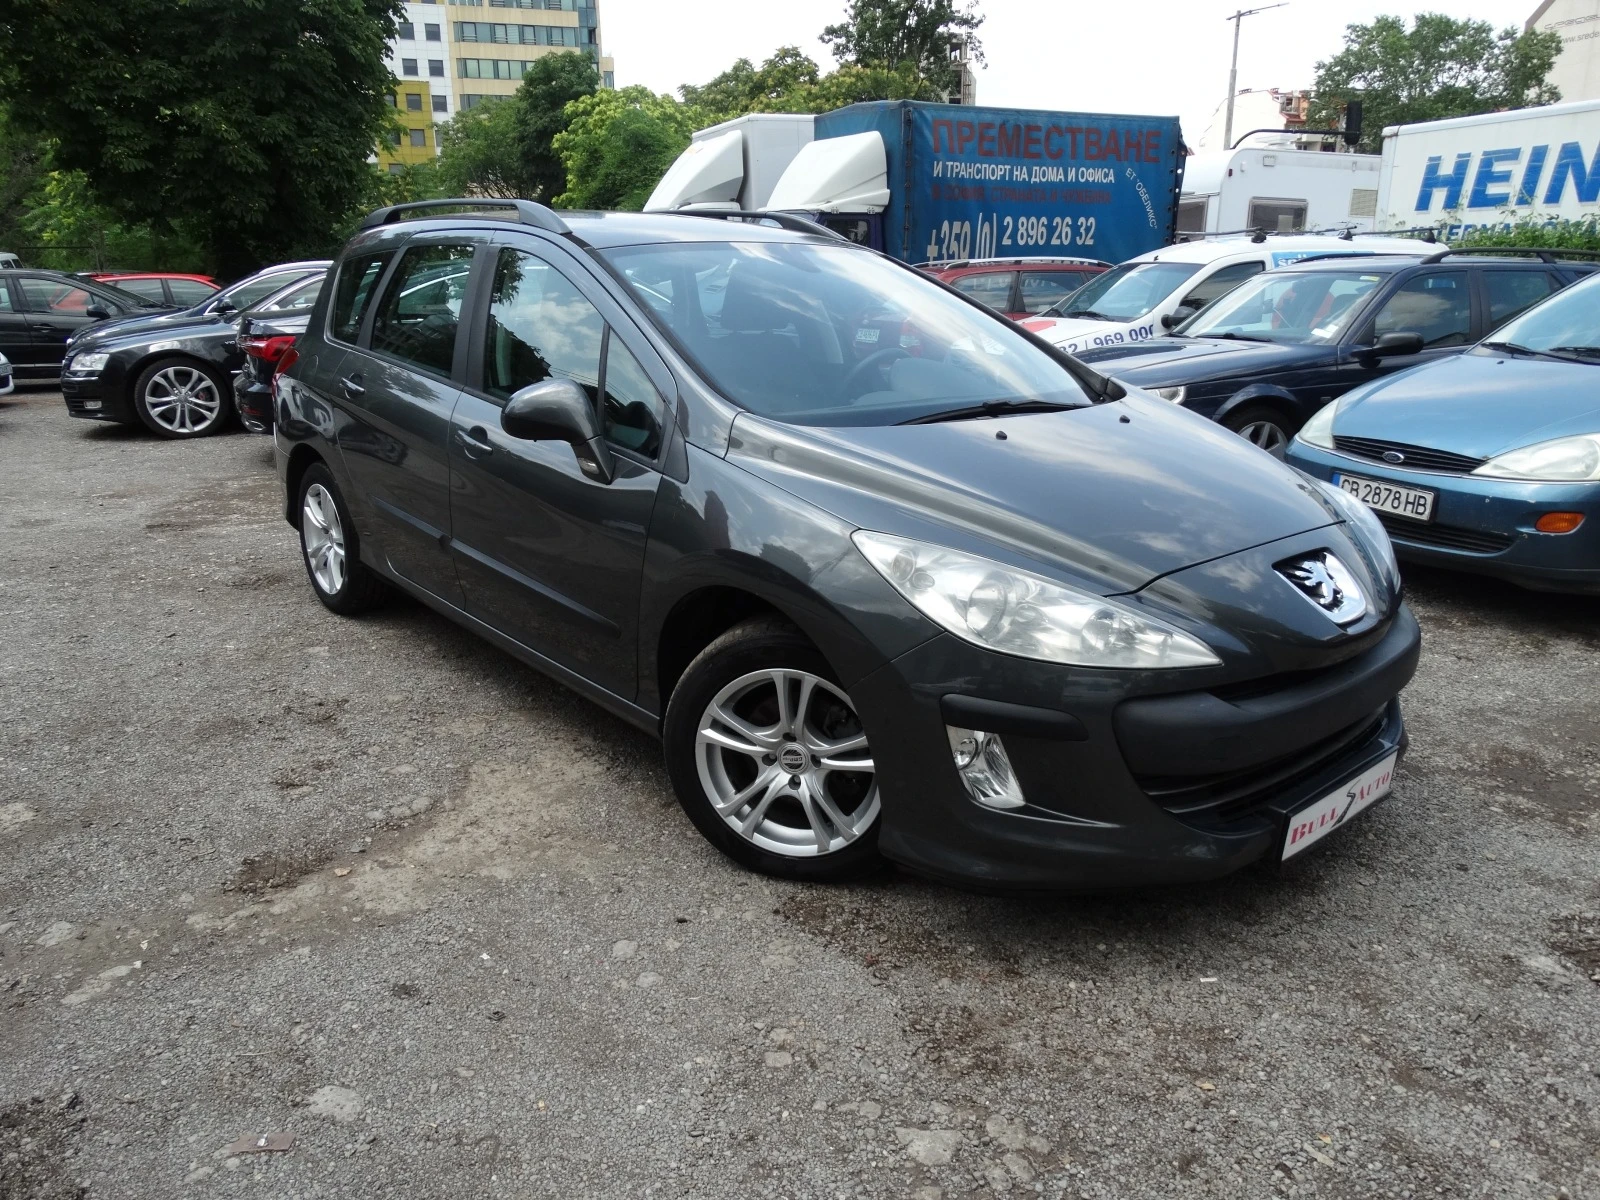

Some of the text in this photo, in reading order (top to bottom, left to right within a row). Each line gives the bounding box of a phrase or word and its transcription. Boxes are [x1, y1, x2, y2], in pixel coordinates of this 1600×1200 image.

[932, 119, 1162, 163] ПРЕМЕСТВАНЕ
[933, 161, 1115, 184] И ТРАНСПОРТ НА ДОМА И ОФИСА
[1002, 215, 1013, 245] 2
[1017, 216, 1048, 246] 896
[1051, 216, 1072, 246] 26
[1076, 216, 1096, 246] 32
[1093, 332, 1125, 347] 969
[1364, 483, 1401, 509] 2878
[1404, 494, 1428, 516] HB
